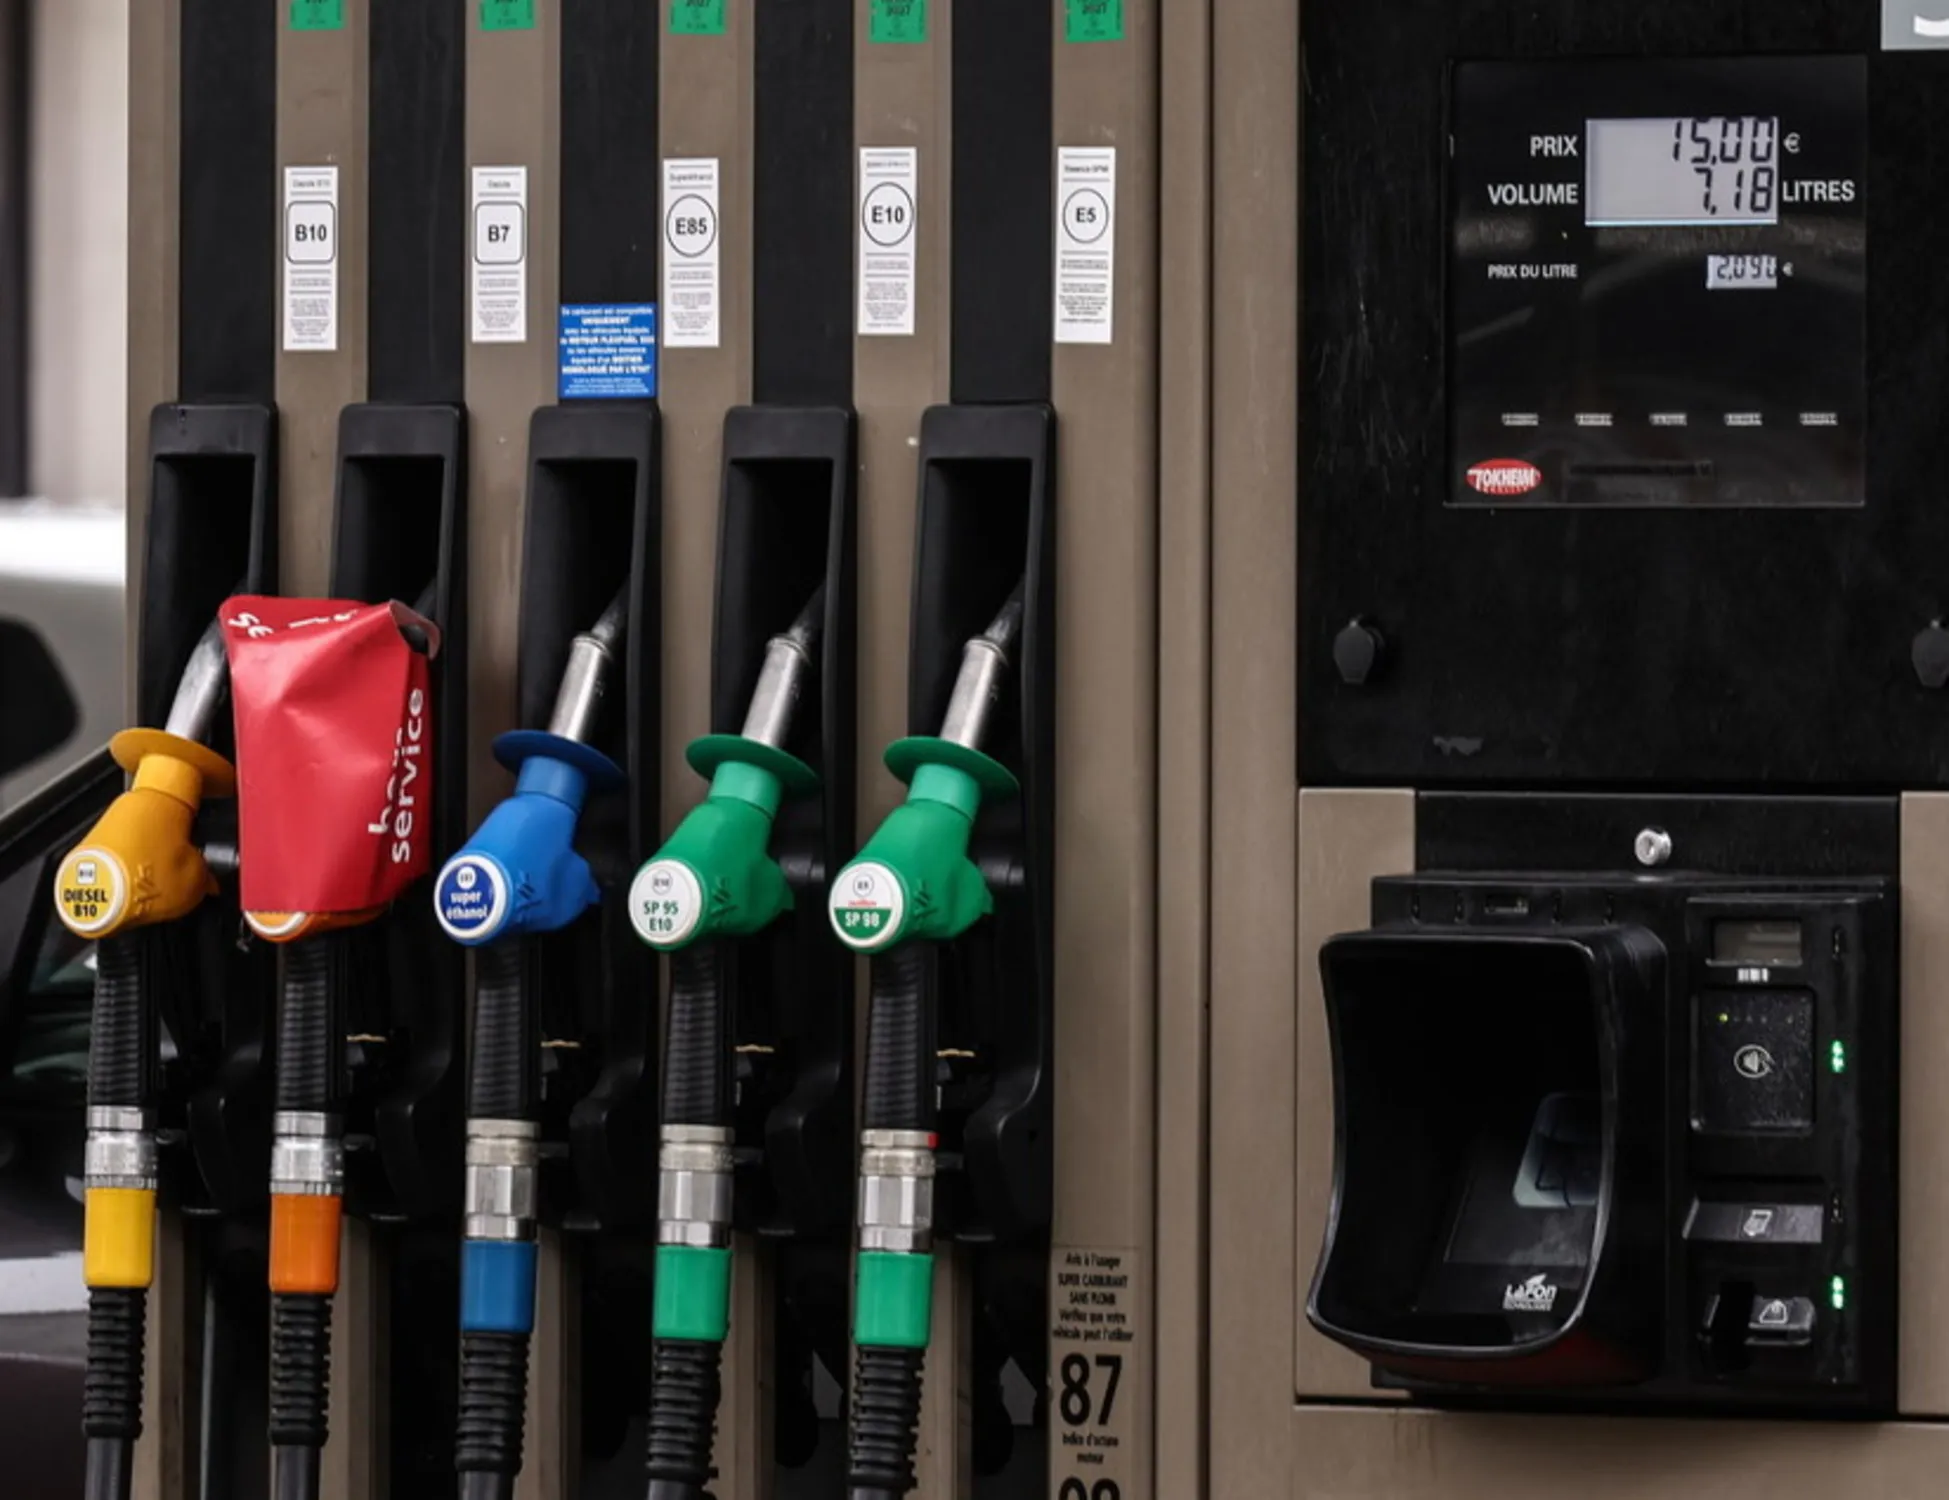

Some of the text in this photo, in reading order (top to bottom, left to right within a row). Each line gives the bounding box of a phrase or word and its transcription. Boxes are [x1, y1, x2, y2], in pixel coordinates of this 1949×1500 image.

[1530, 117, 1800, 165] PRIX 15,00 €
[1487, 167, 1856, 215] VOLUME 7,18 LITRES
[871, 205, 905, 224] E10
[1075, 206, 1097, 224] E5
[294, 223, 328, 242] B10
[488, 224, 511, 243] B7
[675, 217, 708, 235] E85
[1487, 264, 1518, 279] PRIX
[1520, 264, 1540, 278] DU
[1542, 264, 1578, 279] LITRE
[1782, 262, 1794, 276] €
[1467, 467, 1537, 491] TOKHEIM
[392, 688, 424, 863] service
[64, 888, 107, 903] DIESEL
[451, 892, 481, 906] super
[74, 904, 97, 917] B10
[643, 901, 679, 915] SP 95
[649, 918, 673, 932] E10
[845, 912, 880, 927] SP 98
[1060, 1353, 1122, 1426] 87
